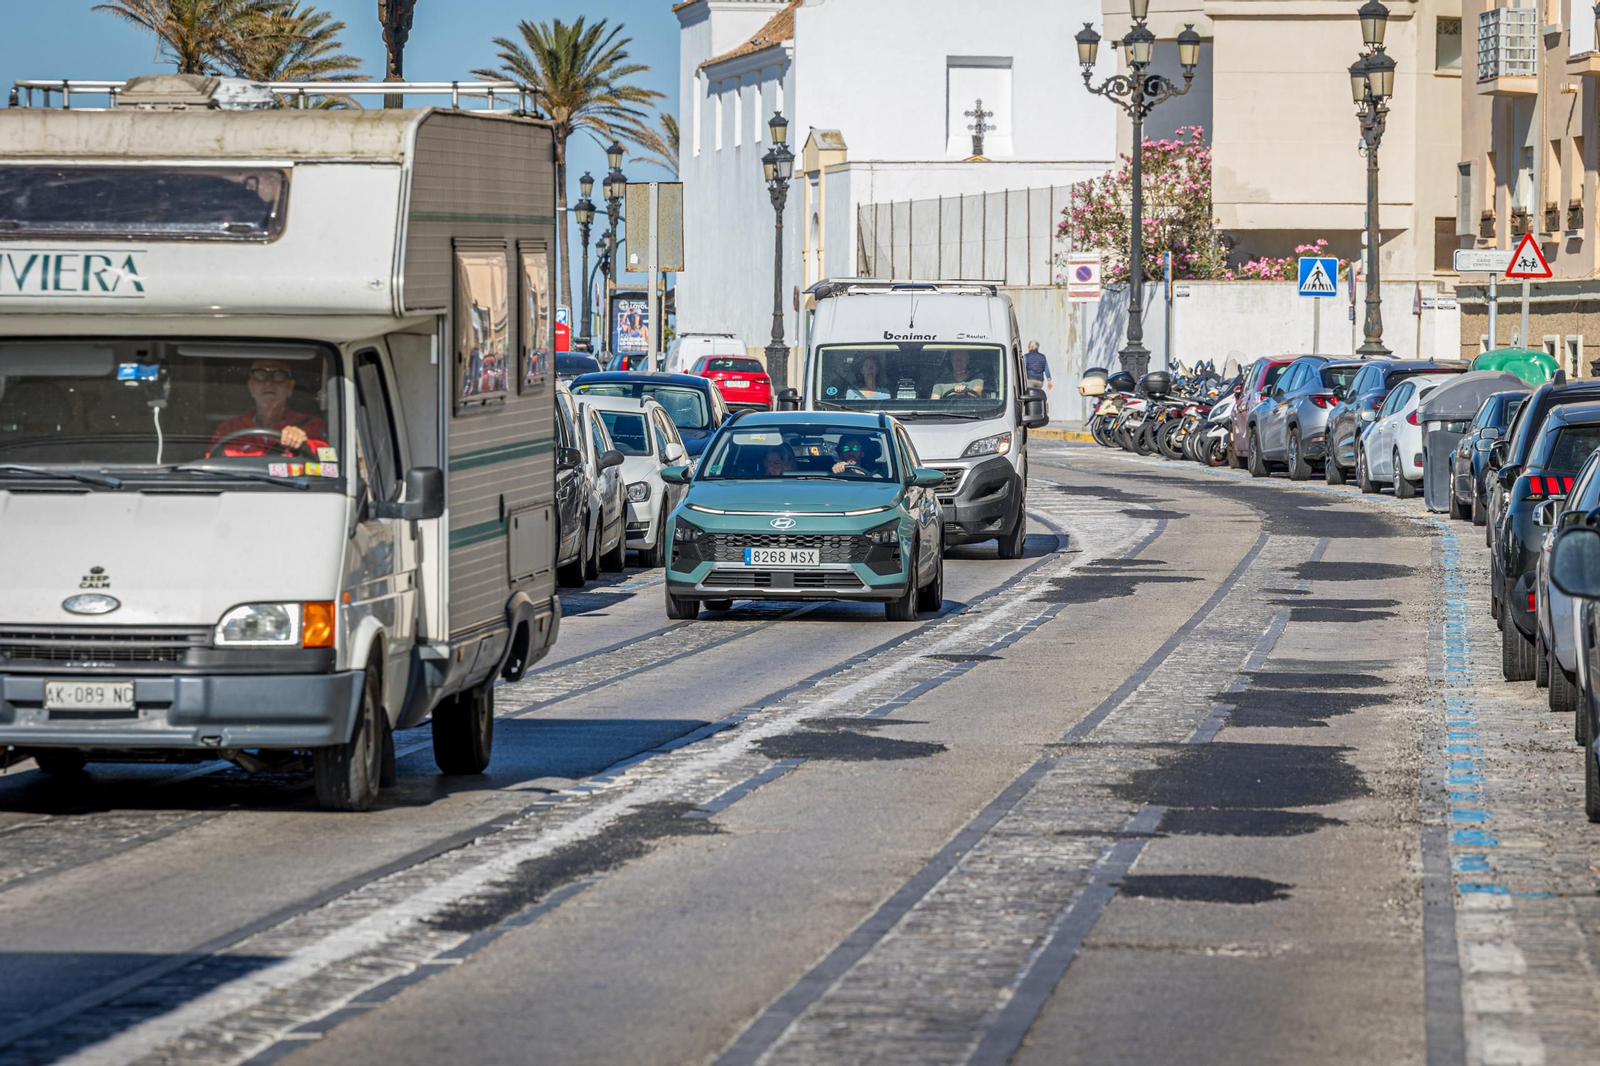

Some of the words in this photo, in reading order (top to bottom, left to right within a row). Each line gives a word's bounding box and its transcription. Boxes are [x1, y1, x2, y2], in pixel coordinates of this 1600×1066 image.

[883, 330, 938, 341] benimar
[753, 550, 786, 563] 8268
[790, 551, 815, 564] MSX
